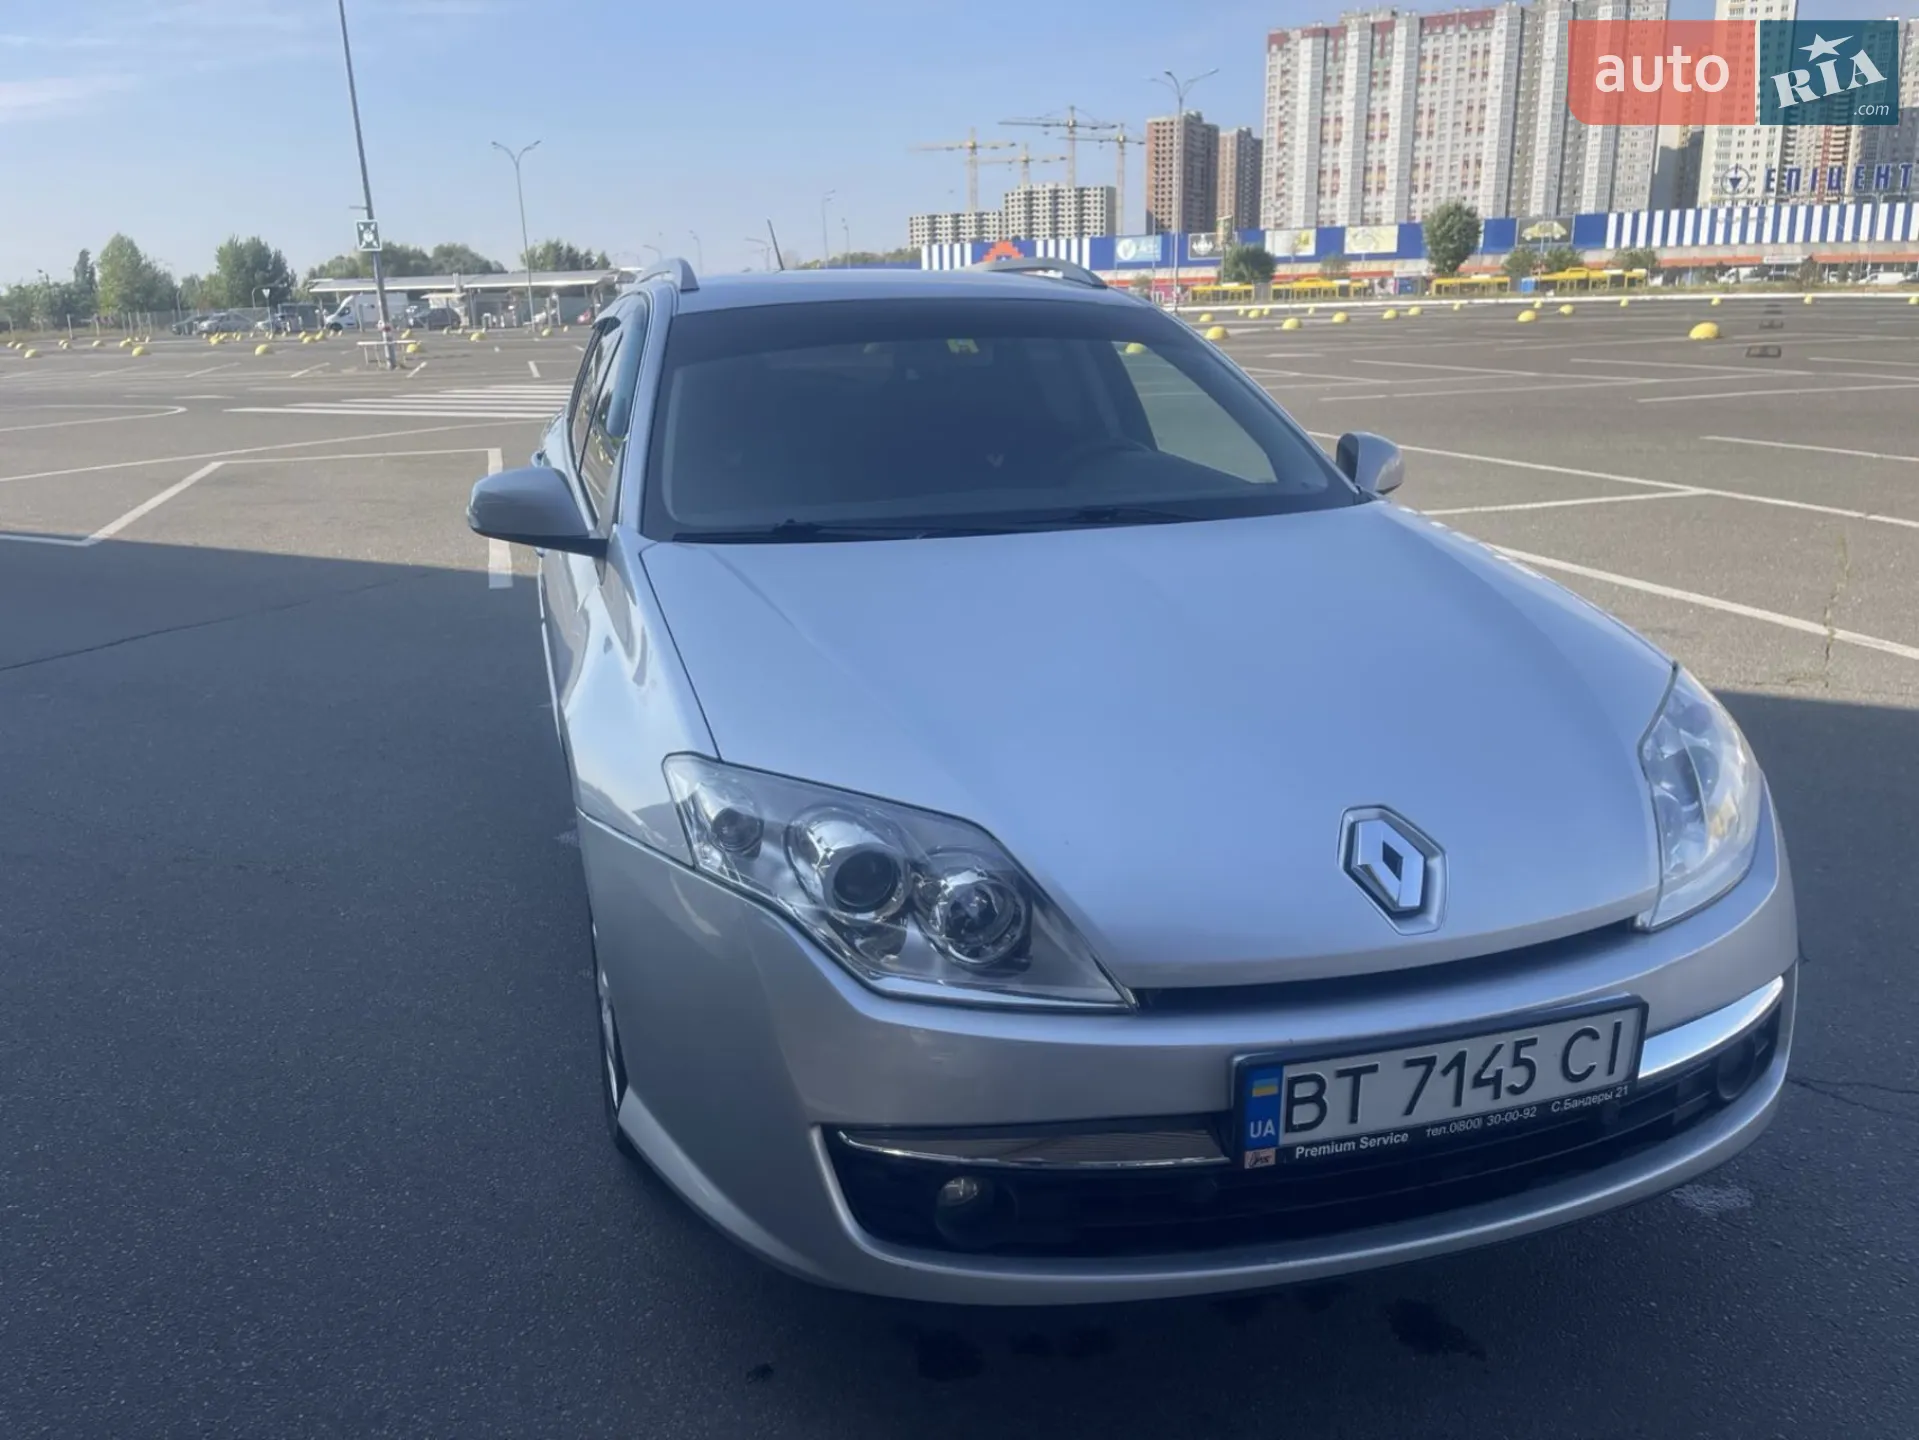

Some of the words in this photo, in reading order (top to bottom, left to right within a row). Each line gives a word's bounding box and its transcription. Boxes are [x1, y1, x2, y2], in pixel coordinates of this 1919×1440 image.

[1285, 1063, 1379, 1133] BT
[1402, 1037, 1539, 1116] 7145
[1561, 1020, 1622, 1083] CI
[1615, 1085, 1629, 1098] 21
[1486, 1106, 1537, 1126] 30-00-92
[1249, 1118, 1276, 1139] UA
[1295, 1140, 1356, 1160] Premium
[1359, 1131, 1409, 1149] Service
